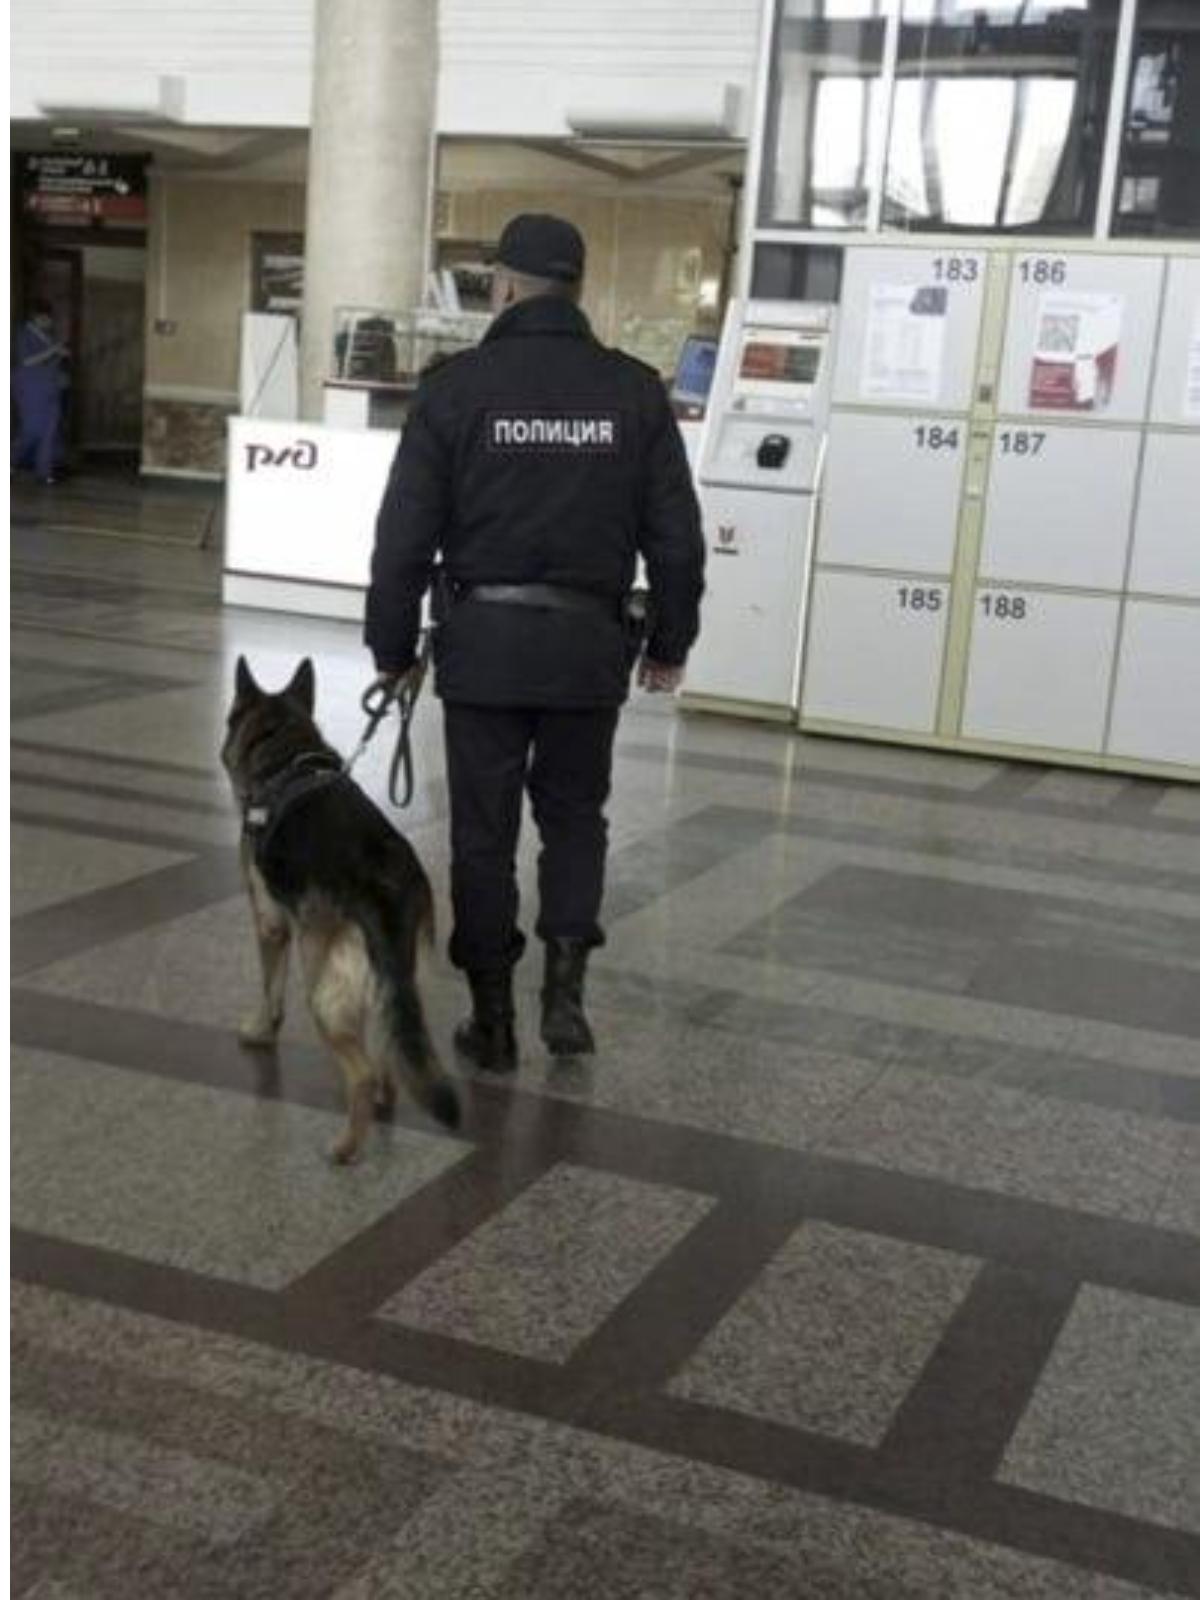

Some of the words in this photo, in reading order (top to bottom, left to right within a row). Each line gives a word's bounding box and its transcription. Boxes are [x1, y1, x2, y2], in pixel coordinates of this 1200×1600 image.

[933, 258, 979, 281] 183
[1020, 259, 1066, 284] 186
[494, 418, 613, 447] ПОЛИЦИЯ
[914, 426, 958, 449] 184
[1000, 431, 1046, 455] 187
[898, 588, 942, 611] 185
[981, 594, 1025, 619] 188
